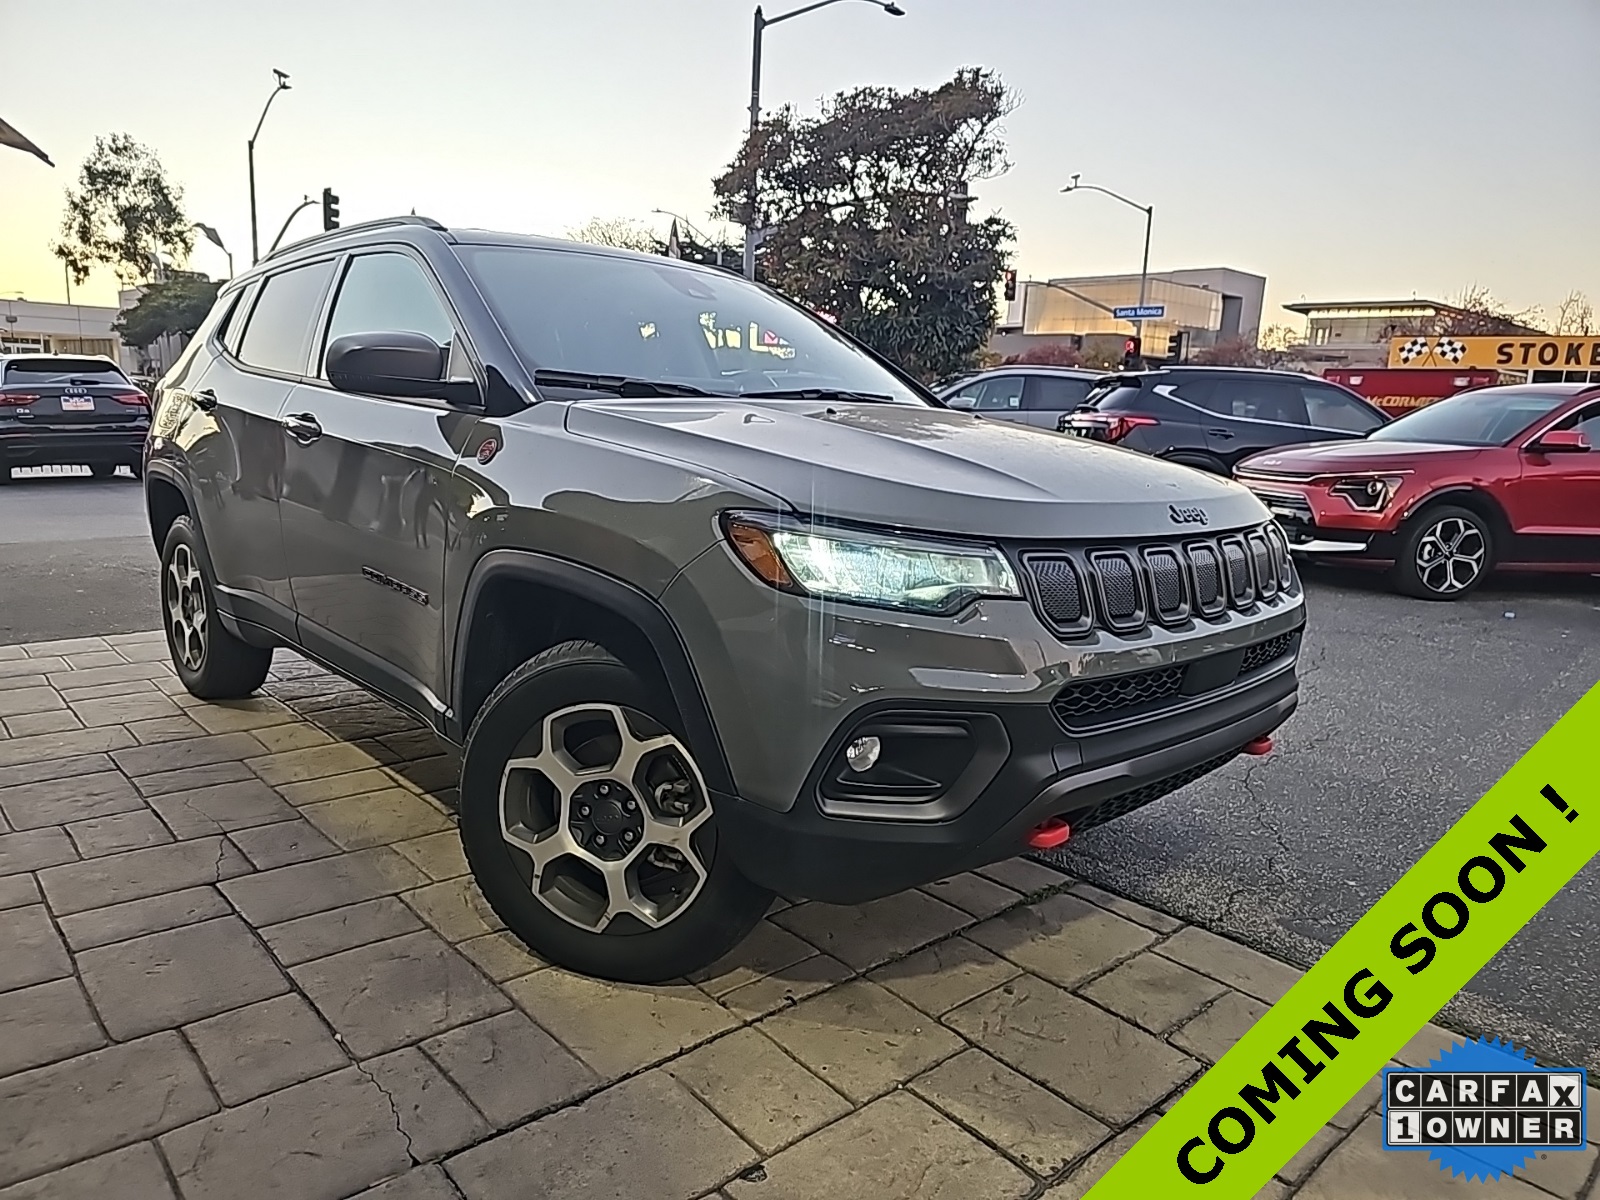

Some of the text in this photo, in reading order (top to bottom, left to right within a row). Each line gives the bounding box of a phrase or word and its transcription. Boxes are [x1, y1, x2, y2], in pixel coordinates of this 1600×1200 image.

[1116, 308, 1163, 317] Santa Monica
[1168, 504, 1209, 526] Jeep
